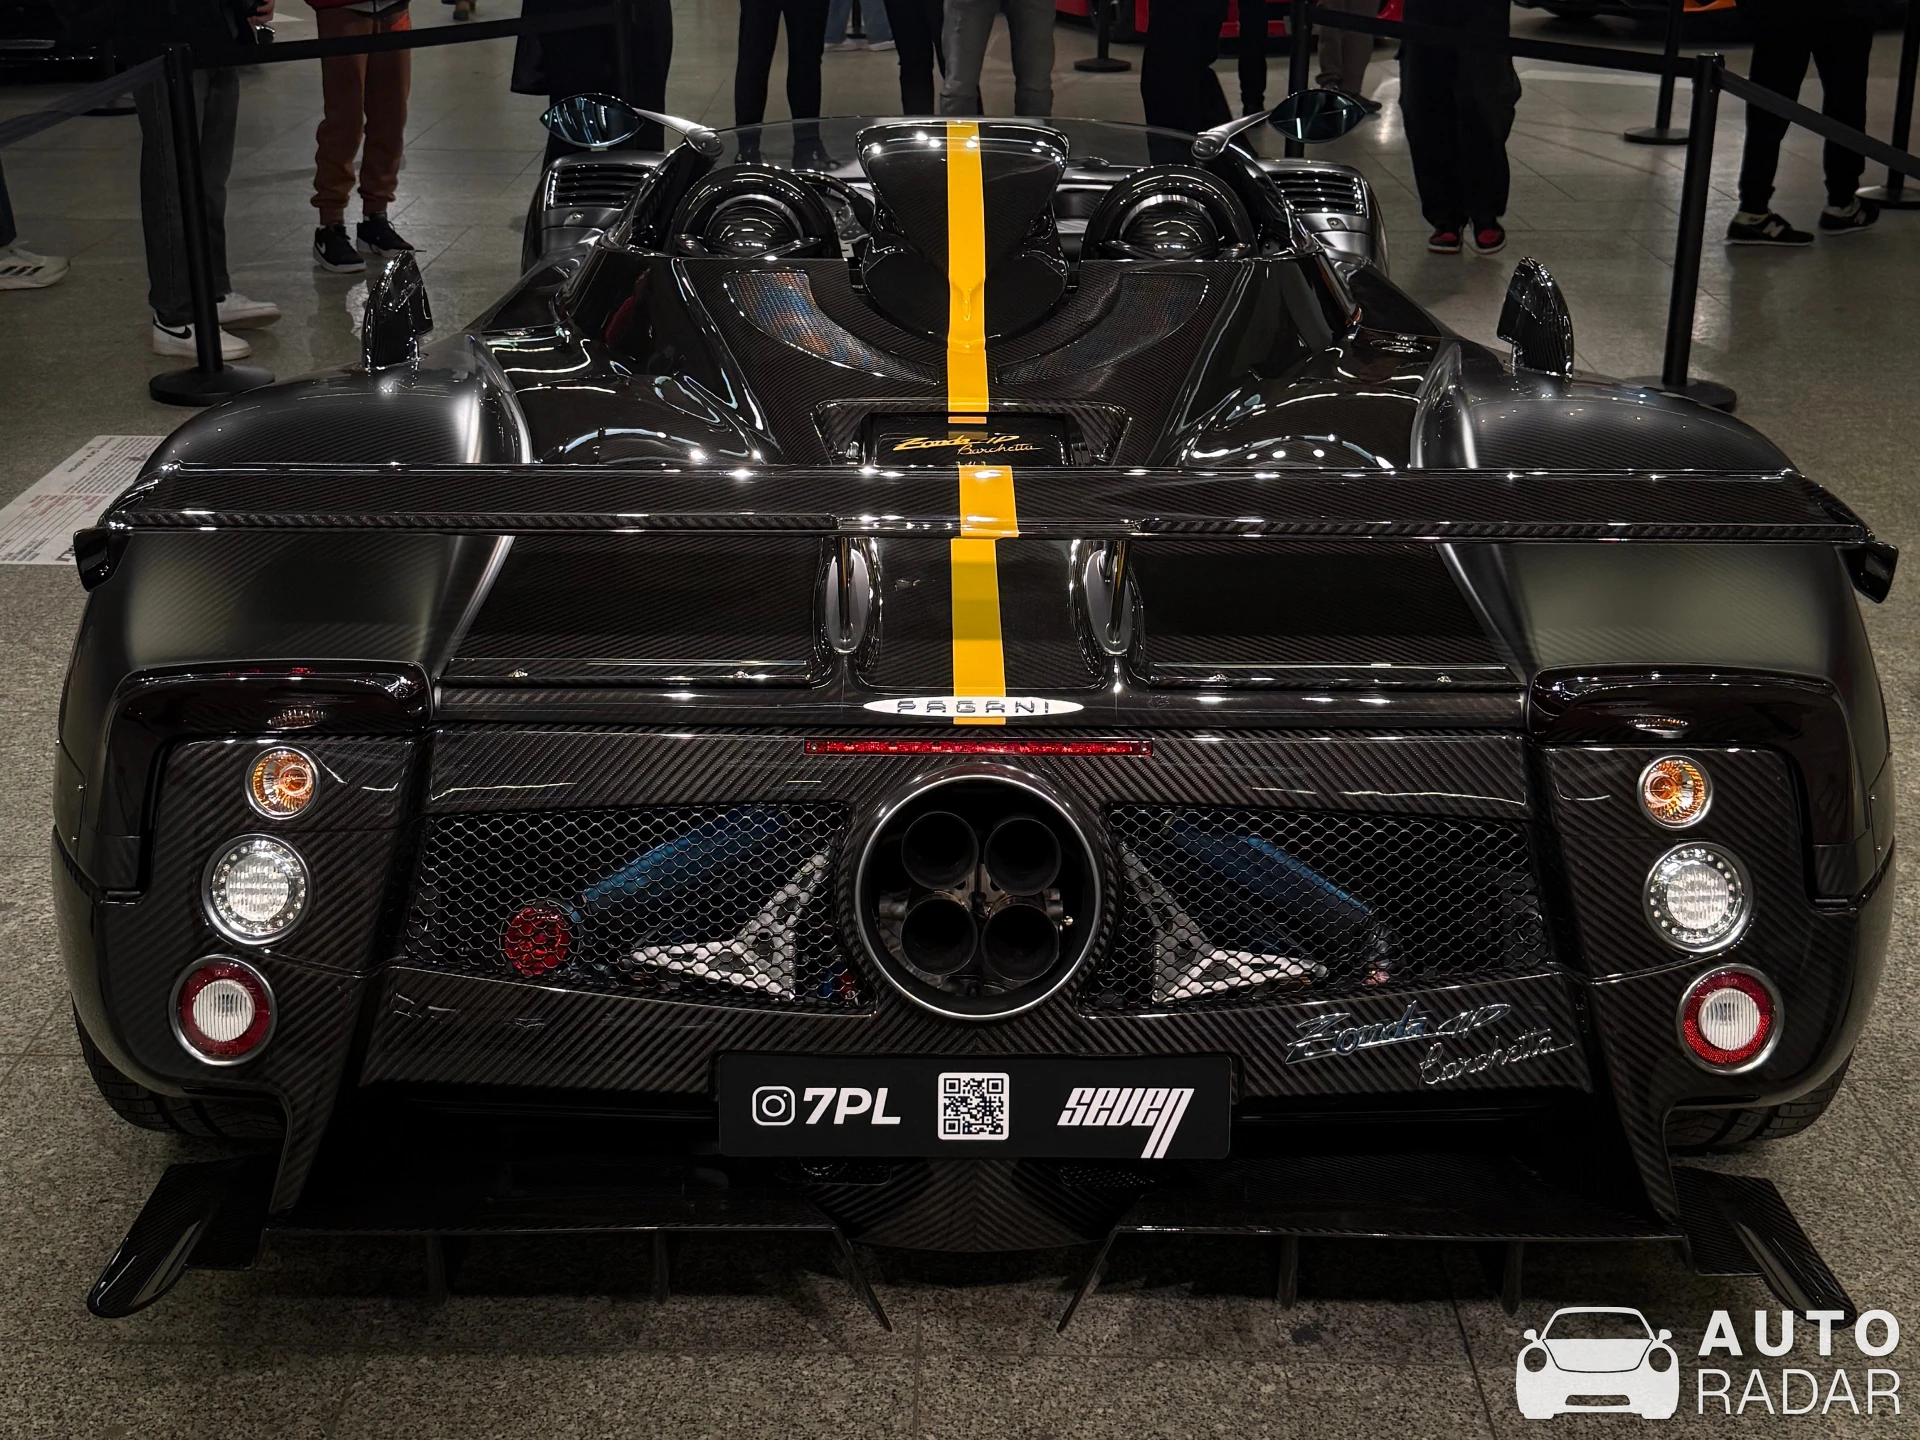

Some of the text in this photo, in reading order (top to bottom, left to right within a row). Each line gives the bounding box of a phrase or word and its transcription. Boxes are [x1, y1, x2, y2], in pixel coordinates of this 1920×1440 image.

[957, 442, 1045, 455] Barchetta
[897, 700, 1049, 713] PAGANI
[1285, 1000, 1428, 1064] Zonda
[1418, 1028, 1574, 1086] Barchetta
[803, 1087, 901, 1125] 7PL
